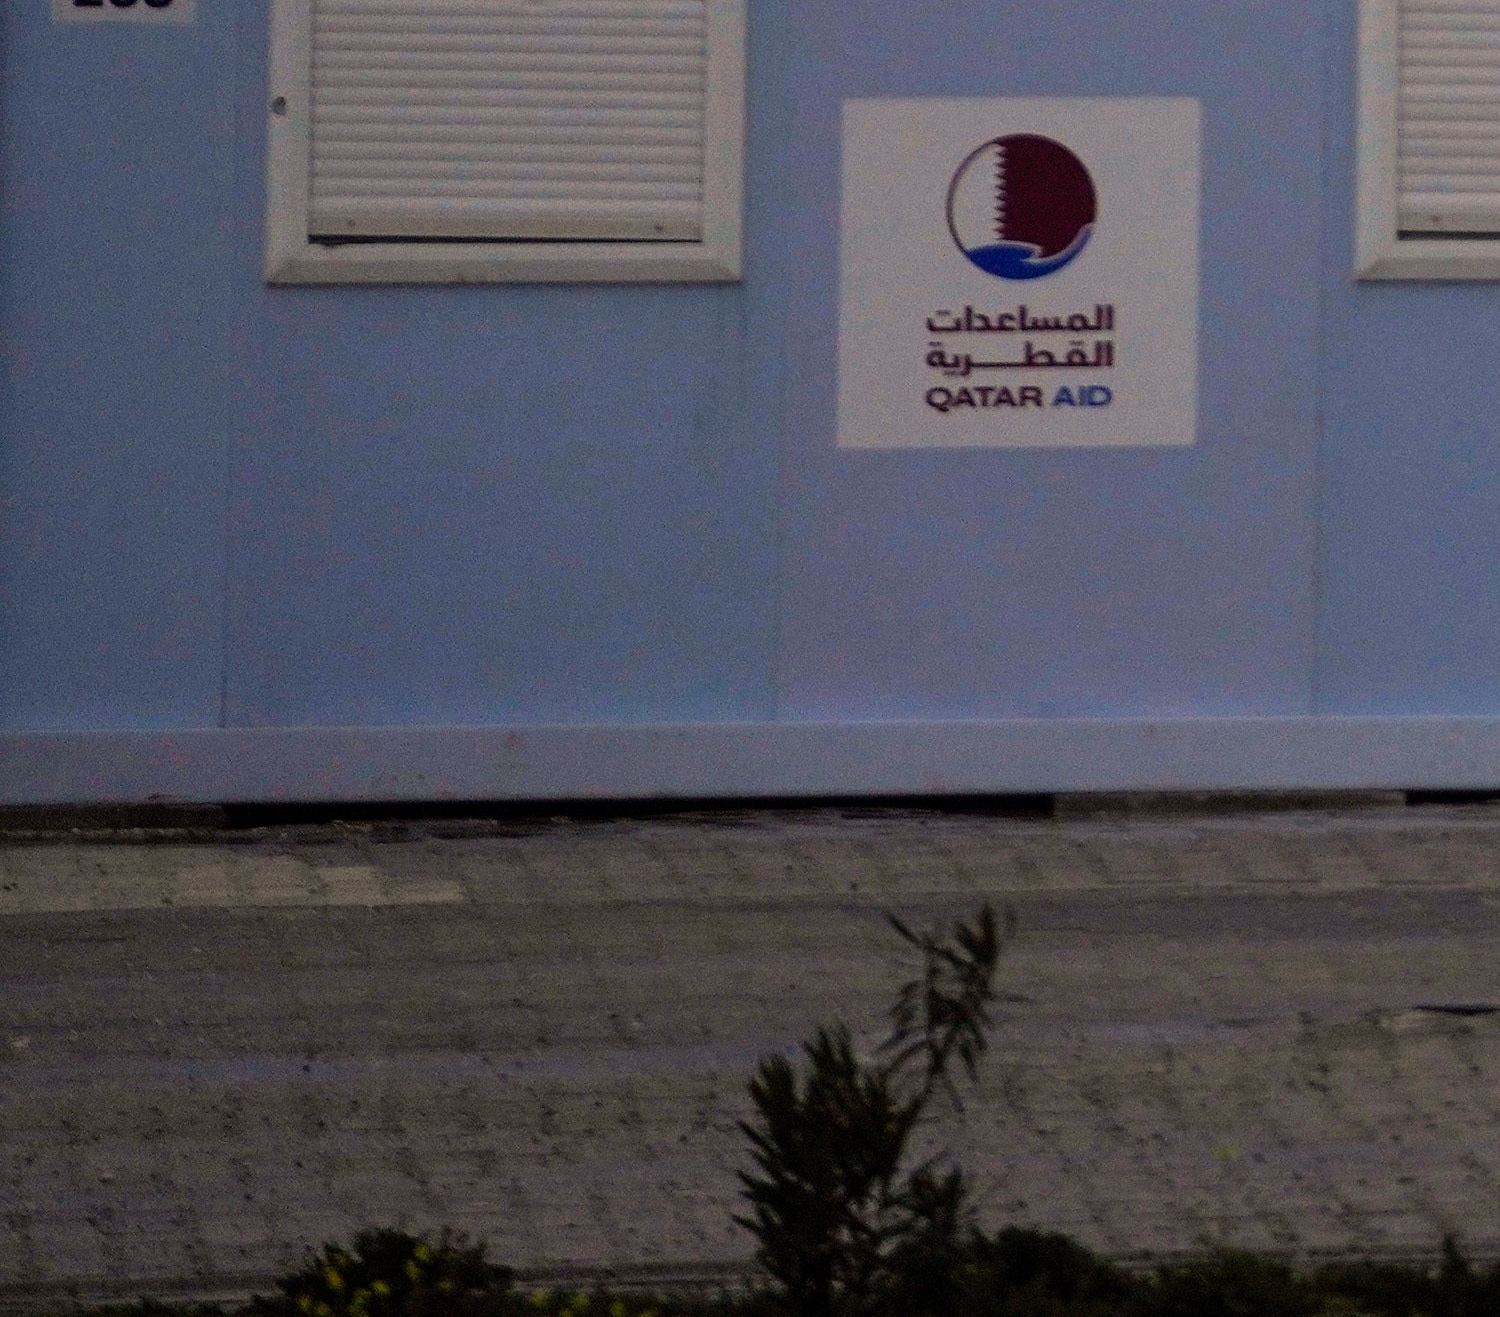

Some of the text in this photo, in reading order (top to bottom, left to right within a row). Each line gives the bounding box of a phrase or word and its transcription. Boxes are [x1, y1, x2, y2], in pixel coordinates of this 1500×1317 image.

[926, 305, 1114, 333] المساعدات
[925, 385, 1113, 413] QATAR AID
